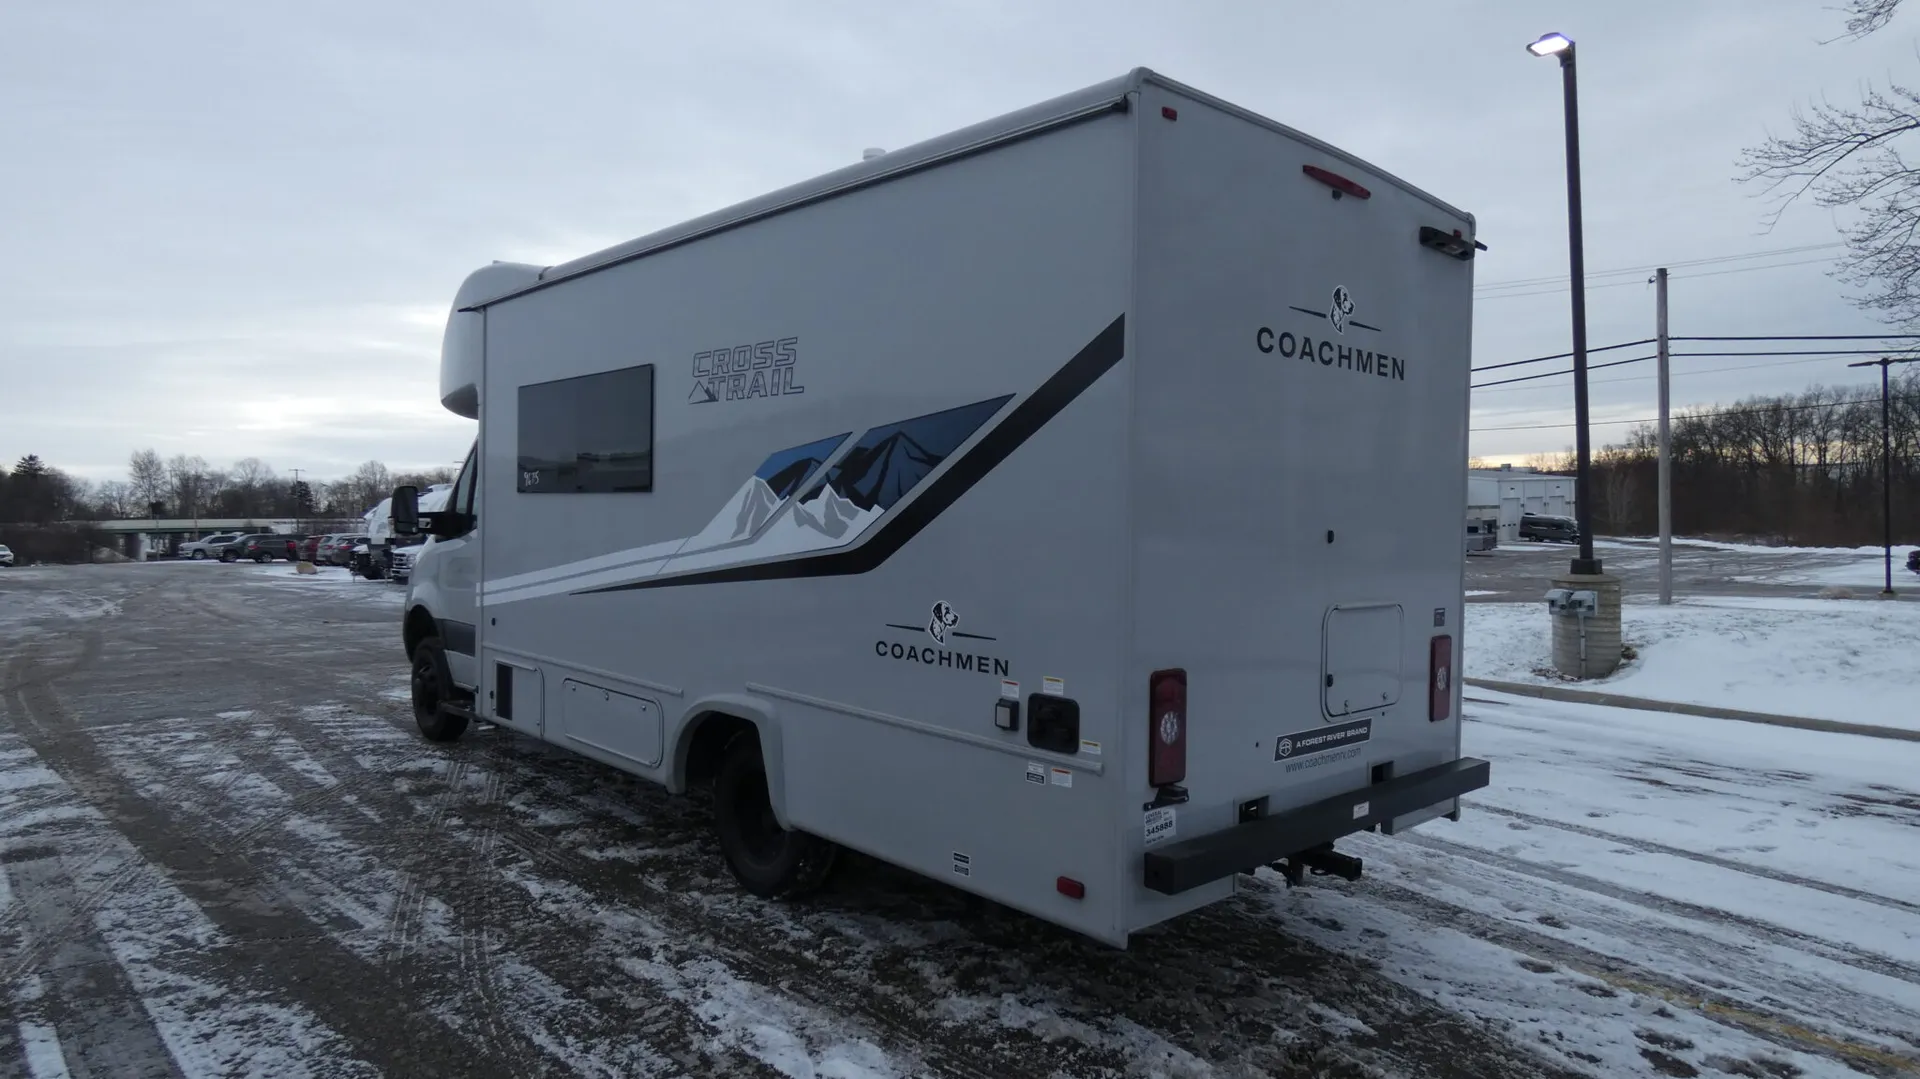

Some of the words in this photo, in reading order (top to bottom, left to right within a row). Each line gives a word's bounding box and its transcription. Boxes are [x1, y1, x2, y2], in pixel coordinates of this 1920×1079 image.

[692, 336, 798, 378] CROSS
[1256, 326, 1405, 381] COACHMEN
[708, 366, 805, 401] TRAIL
[875, 640, 1009, 677] COACHMEN
[1295, 740, 1302, 749] A
[1301, 735, 1327, 748] FOREST
[1326, 731, 1346, 742] RIVER
[1346, 726, 1368, 738] BRAND
